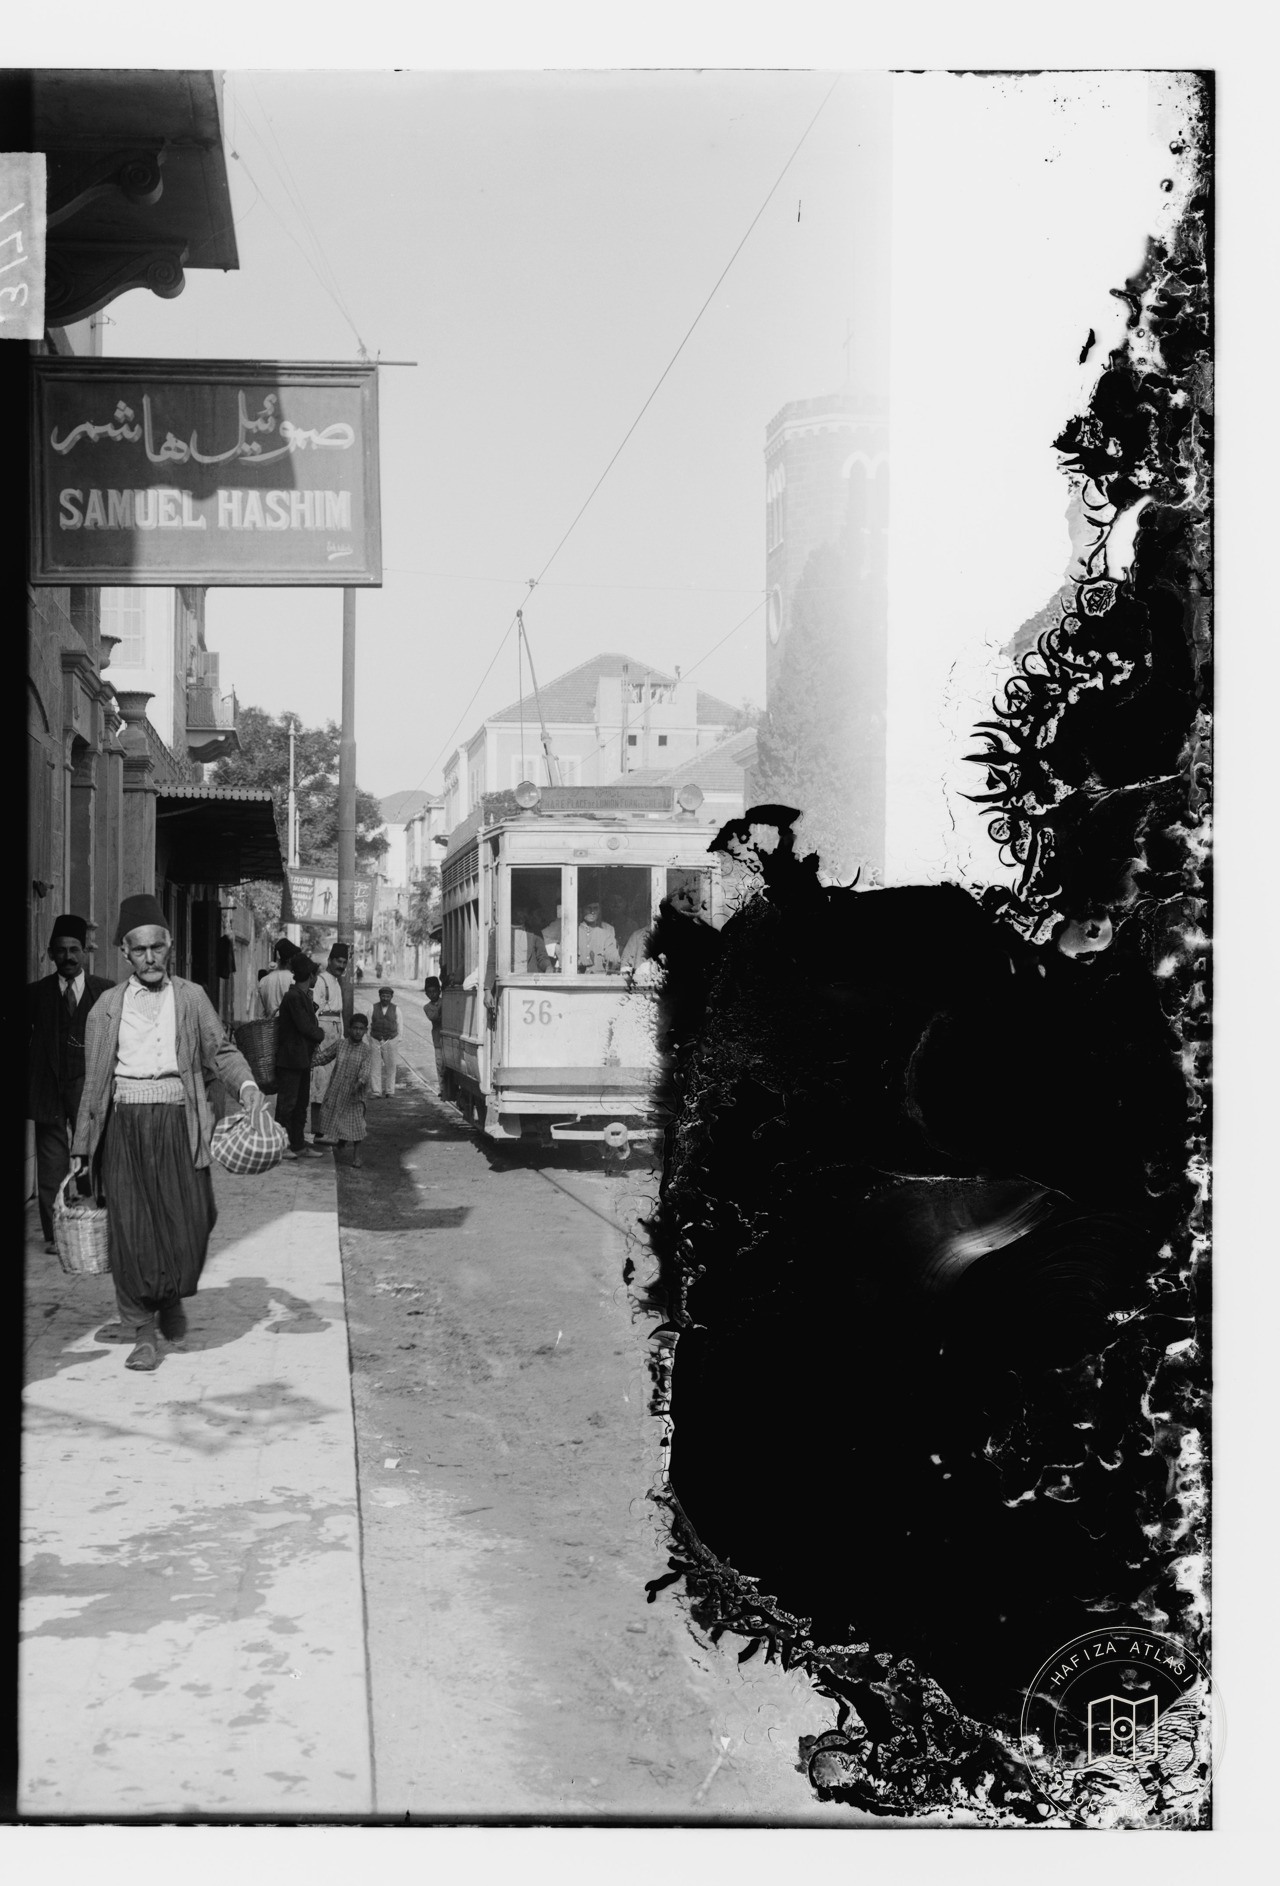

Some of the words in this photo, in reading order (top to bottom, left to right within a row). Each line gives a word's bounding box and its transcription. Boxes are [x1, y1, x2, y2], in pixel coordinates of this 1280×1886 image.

[59, 487, 207, 531] SAMUEL
[217, 489, 352, 532] HASHIM
[522, 999, 552, 1025] 36
